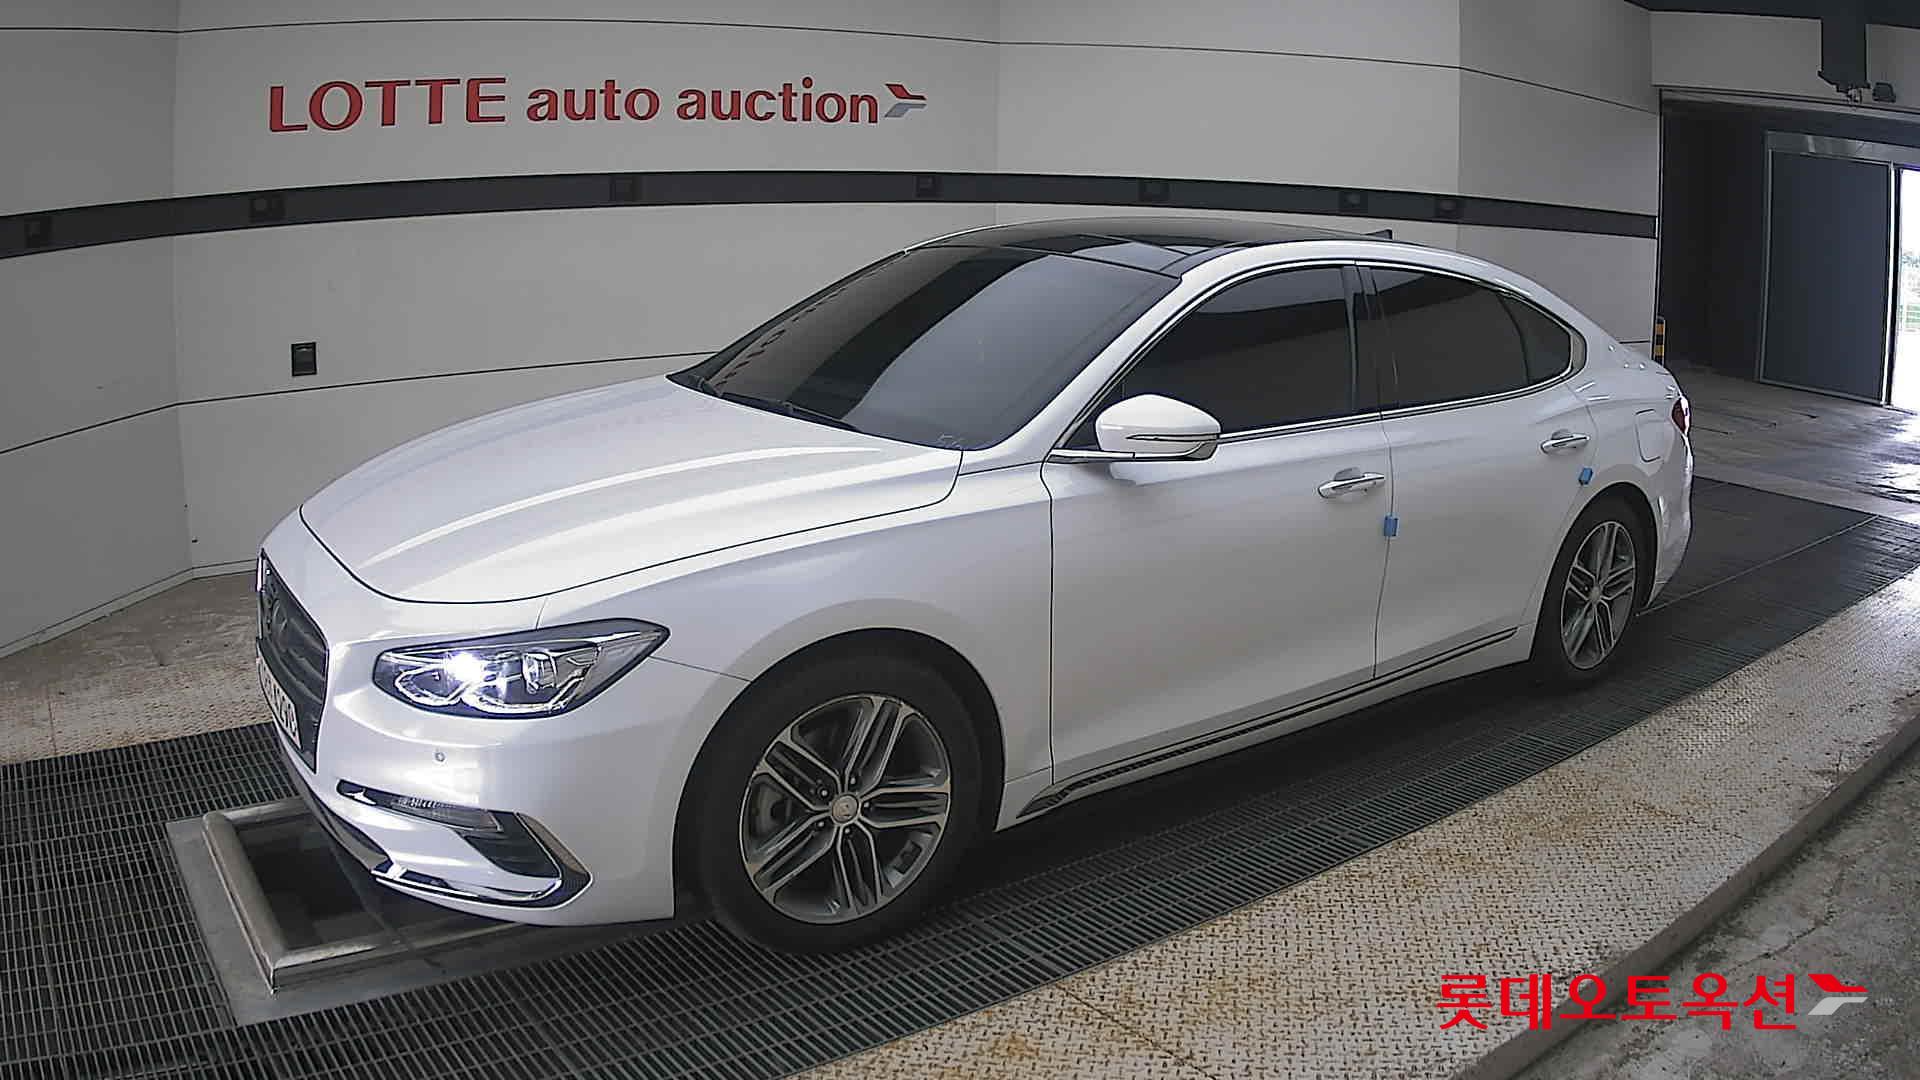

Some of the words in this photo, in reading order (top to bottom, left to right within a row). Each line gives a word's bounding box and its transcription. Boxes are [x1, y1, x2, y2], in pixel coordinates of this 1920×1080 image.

[269, 78, 506, 132] LOTTE
[526, 80, 660, 122] auto
[676, 78, 879, 124] auction
